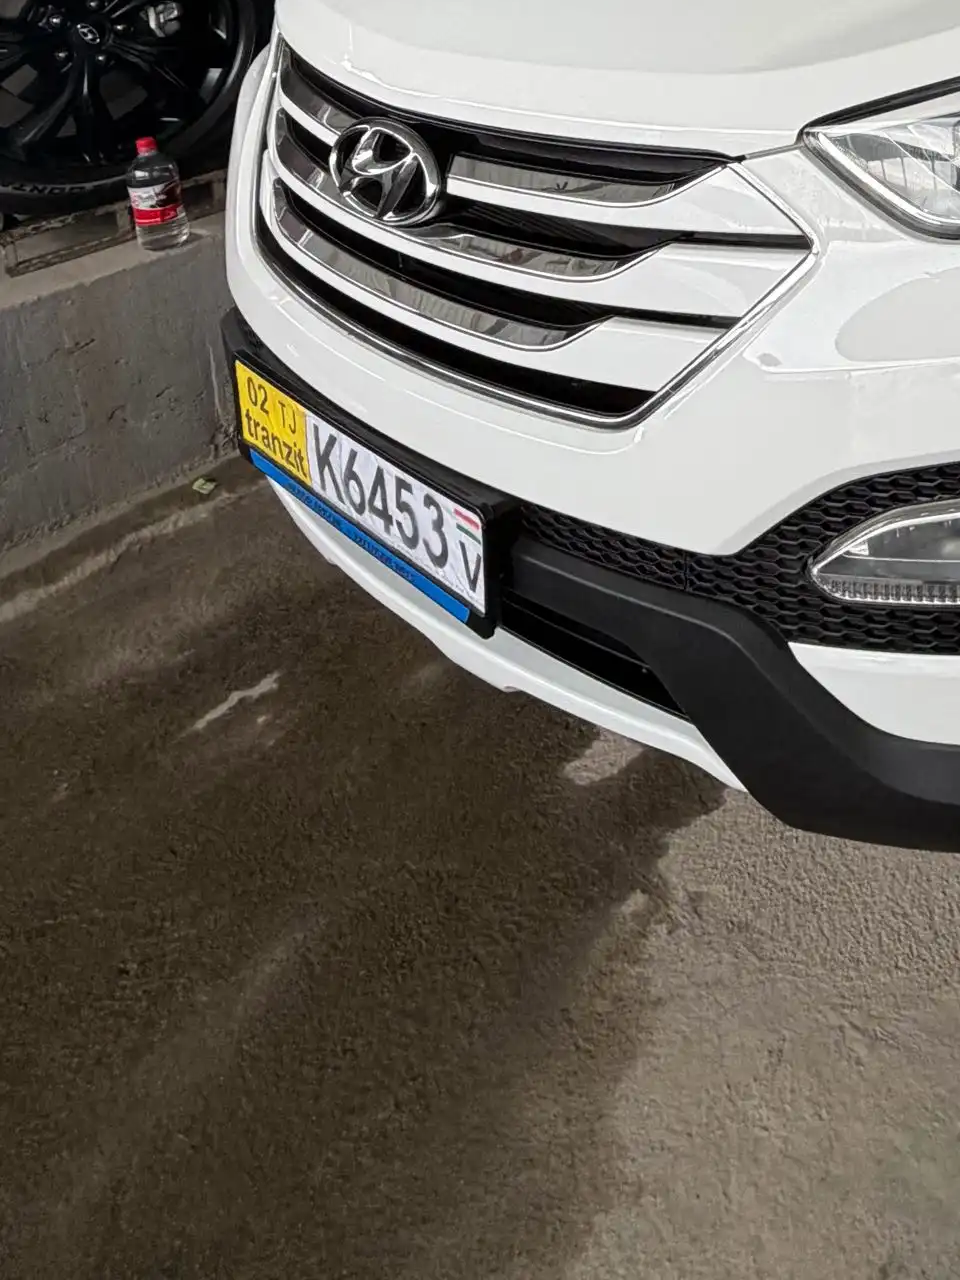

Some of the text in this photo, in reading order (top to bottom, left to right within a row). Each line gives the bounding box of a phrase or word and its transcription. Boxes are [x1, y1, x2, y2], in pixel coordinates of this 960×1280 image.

[246, 376, 297, 434] 02 TJ
[244, 409, 308, 479] tranzit
[313, 423, 449, 569] K6453
